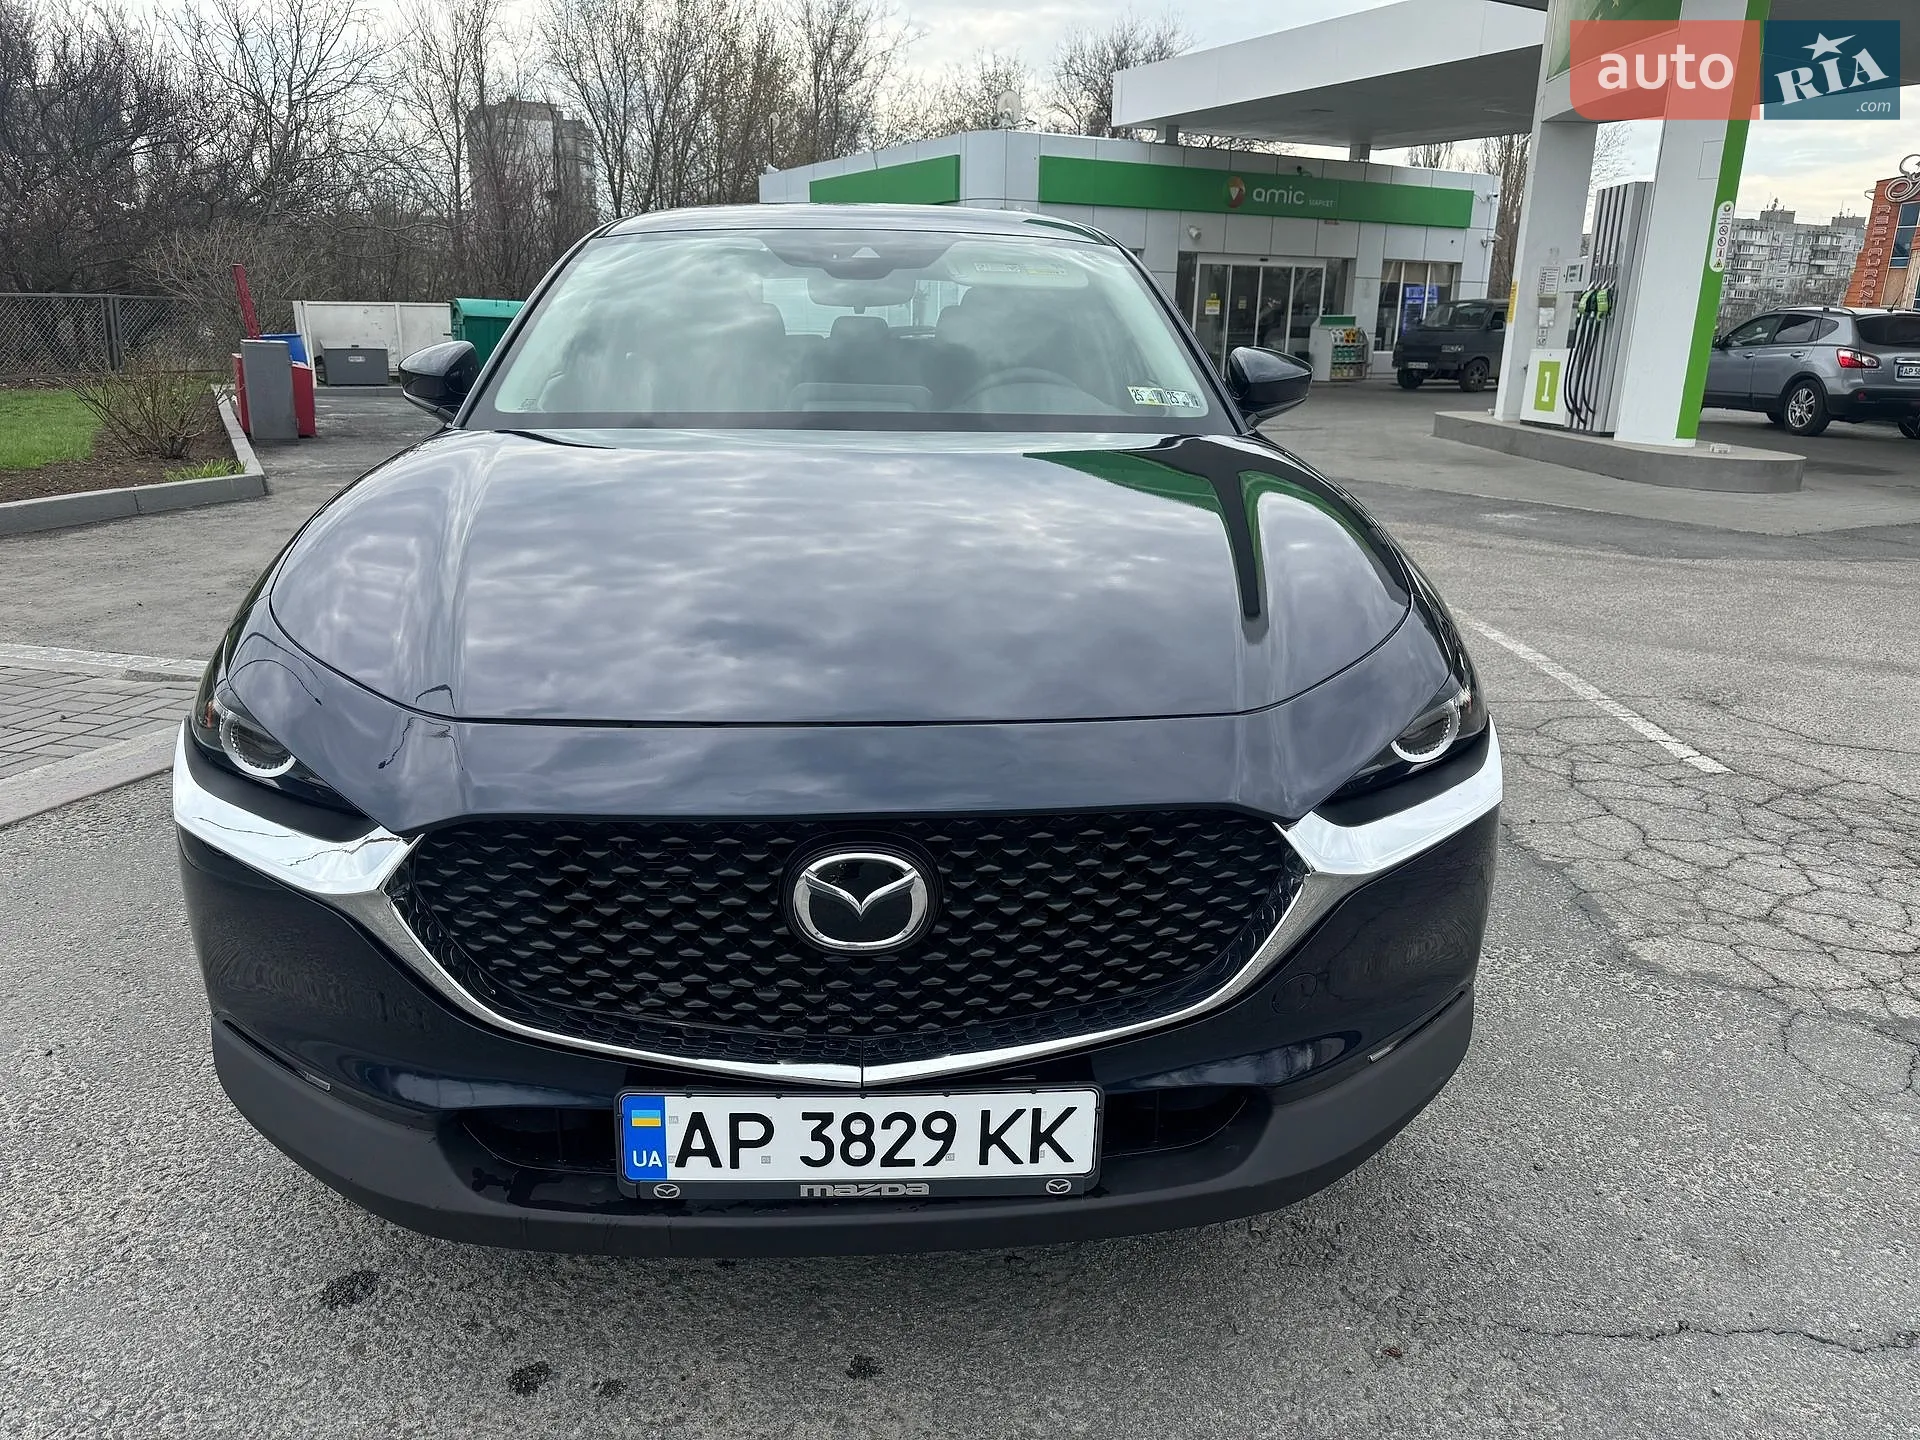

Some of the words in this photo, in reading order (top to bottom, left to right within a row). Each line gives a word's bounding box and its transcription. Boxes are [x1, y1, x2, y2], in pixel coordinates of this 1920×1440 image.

[1252, 185, 1305, 205] amic
[1541, 371, 1551, 402] 1
[674, 1111, 775, 1170] AP
[799, 1110, 958, 1169] 3829
[978, 1106, 1078, 1166] KK
[632, 1150, 663, 1168] UA
